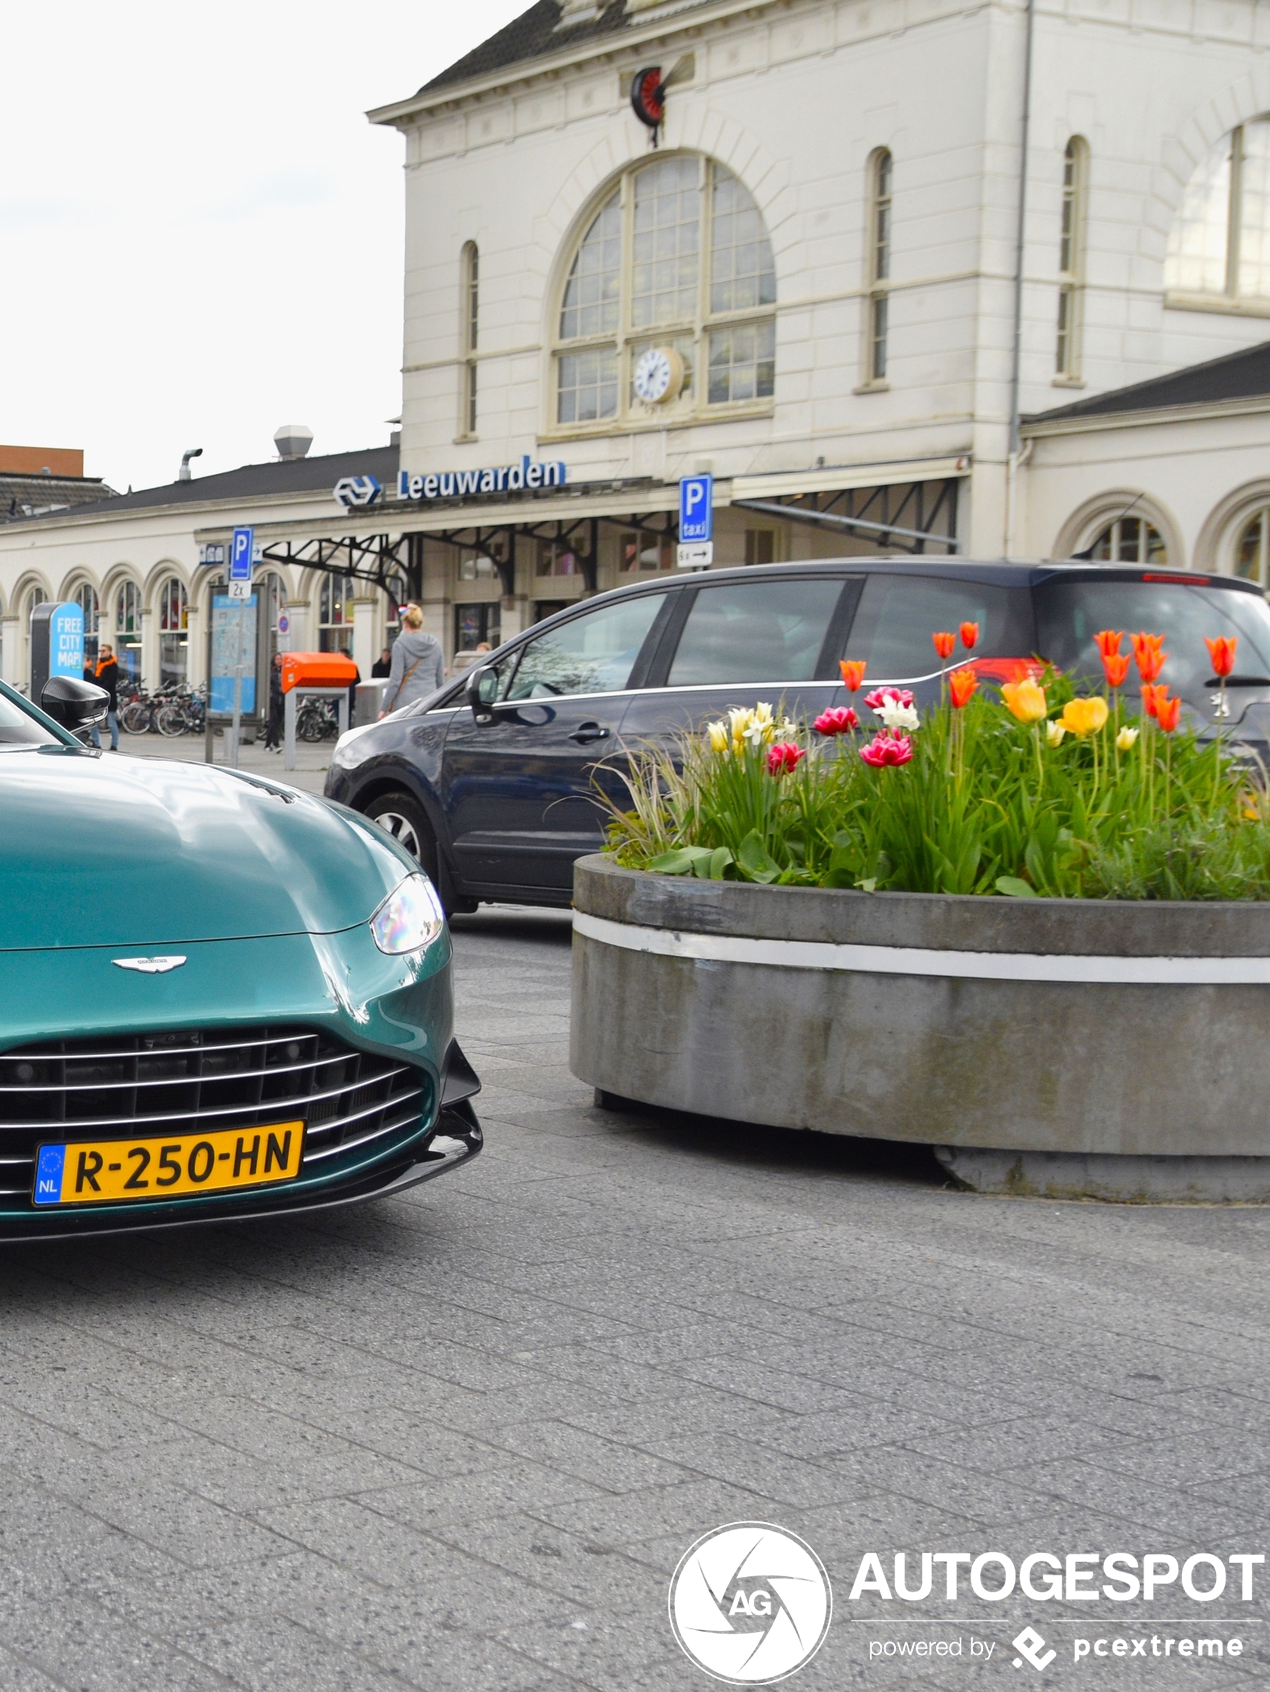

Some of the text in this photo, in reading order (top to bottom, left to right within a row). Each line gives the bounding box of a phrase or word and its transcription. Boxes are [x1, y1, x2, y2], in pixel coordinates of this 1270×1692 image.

[397, 455, 564, 500] Leeuwarden
[686, 482, 704, 516] P
[683, 521, 706, 537] taxi
[235, 534, 247, 561] P
[233, 583, 245, 597] 2x
[57, 617, 82, 633] FREE
[60, 634, 80, 650] CITY
[75, 1130, 292, 1193] R-250-HN
[39, 1179, 58, 1193] NL
